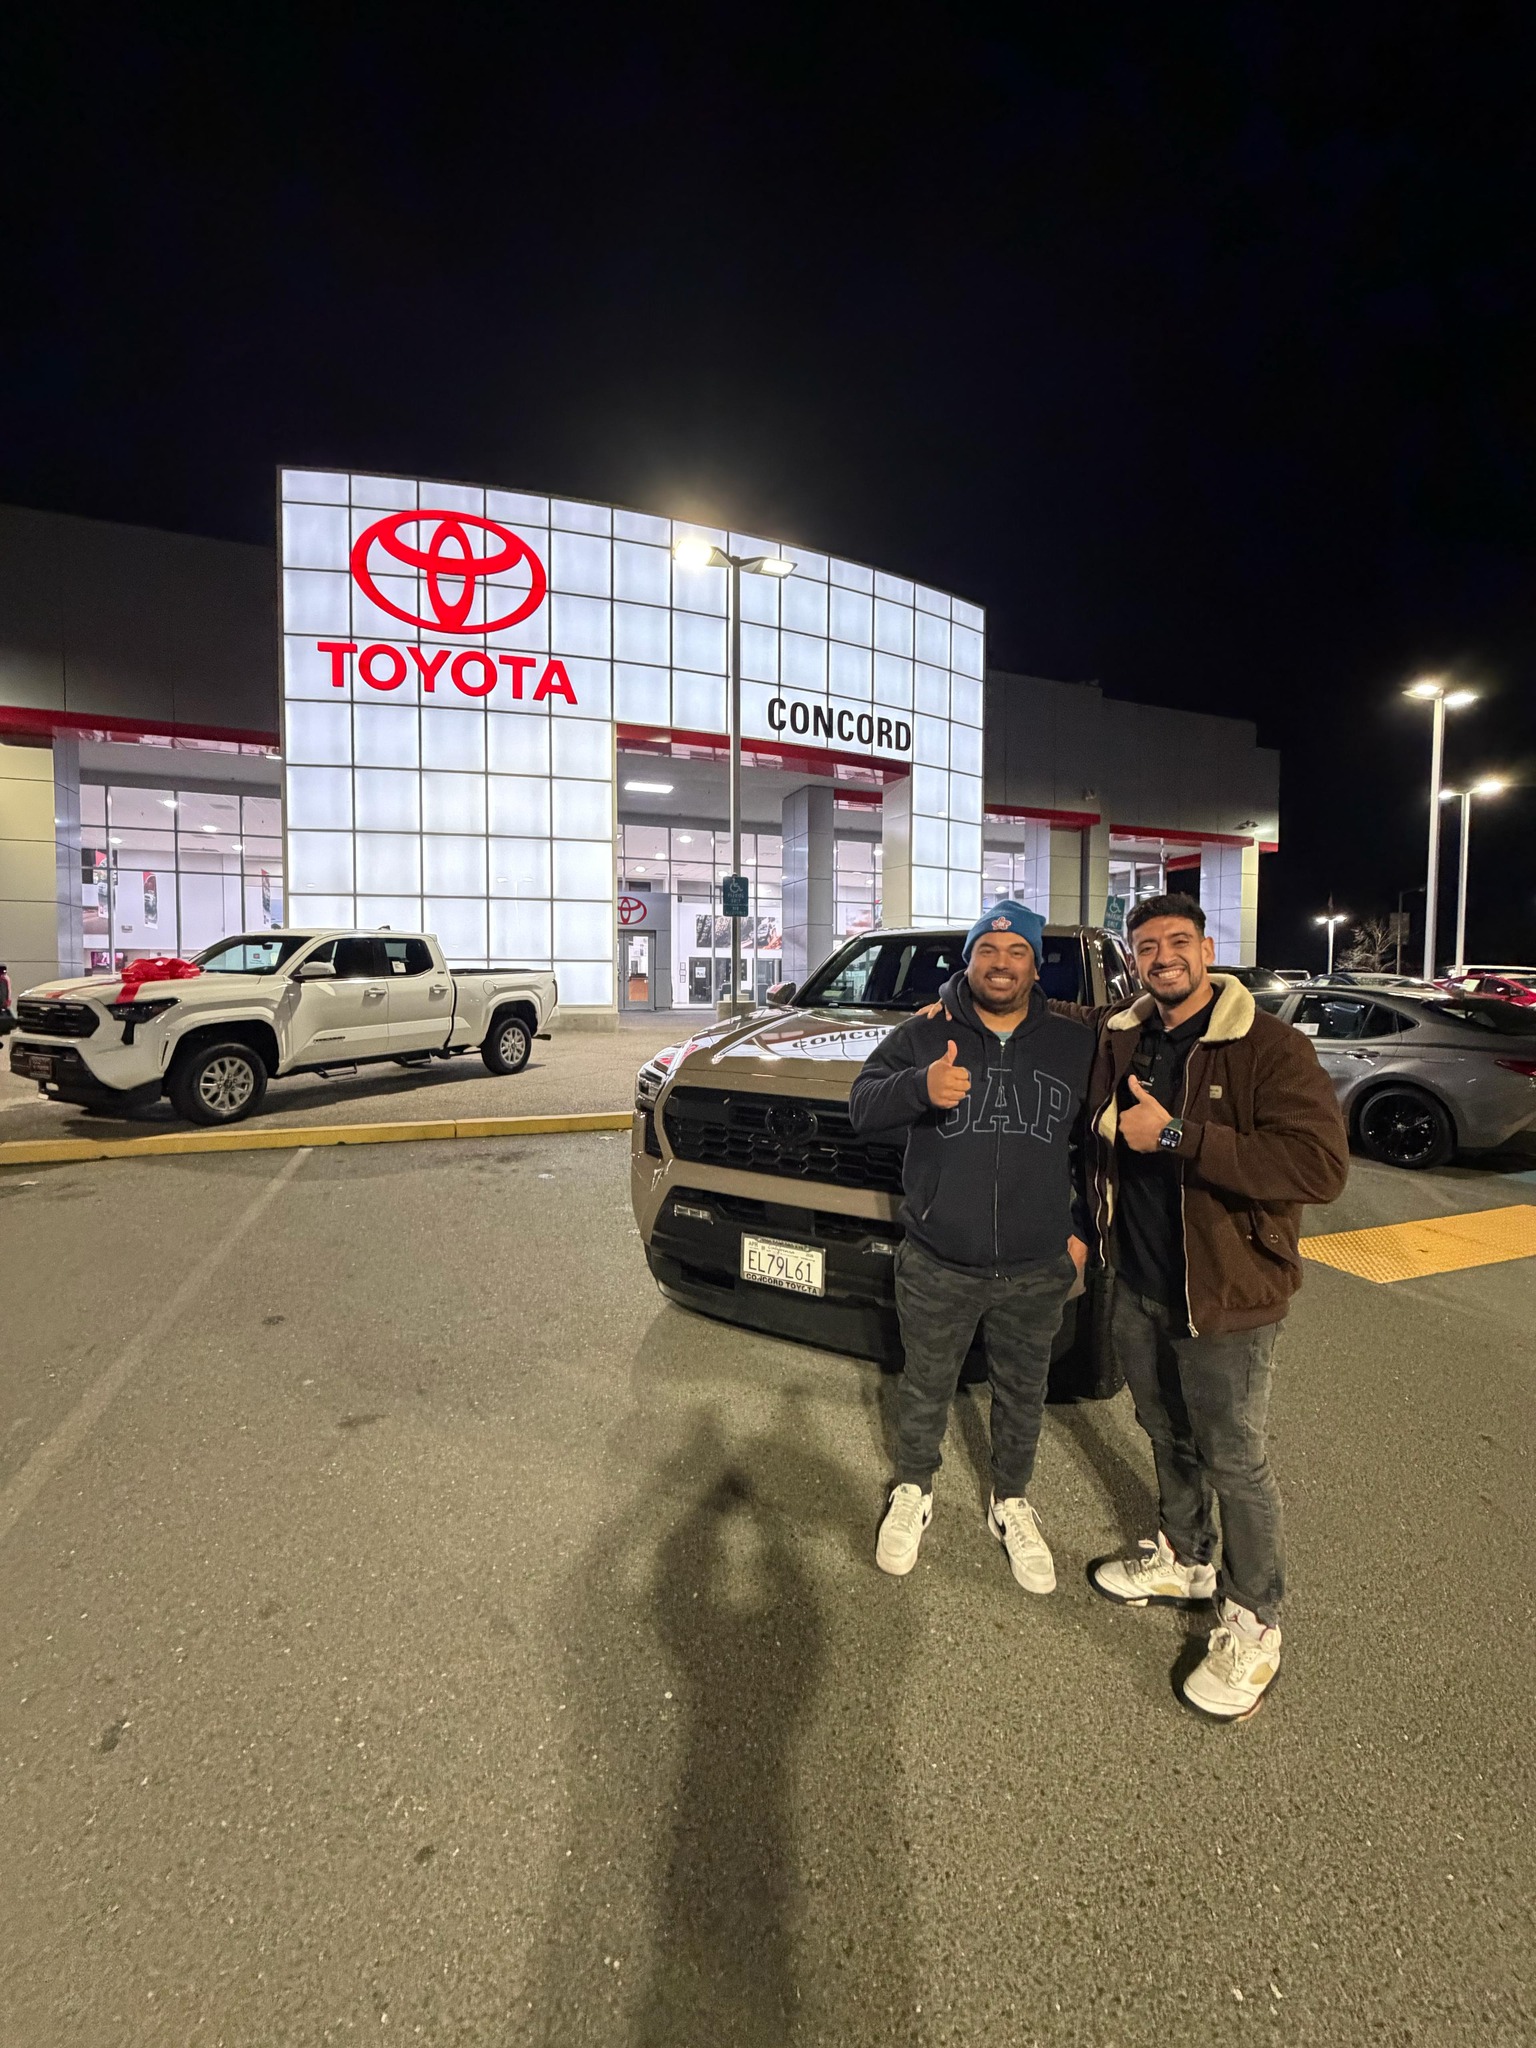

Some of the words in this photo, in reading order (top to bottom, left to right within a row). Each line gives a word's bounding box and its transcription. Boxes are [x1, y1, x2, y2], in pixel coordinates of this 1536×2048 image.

[317, 641, 578, 705] TOYOTA
[768, 698, 911, 751] CONCORD
[748, 1249, 813, 1284] EL79L61
